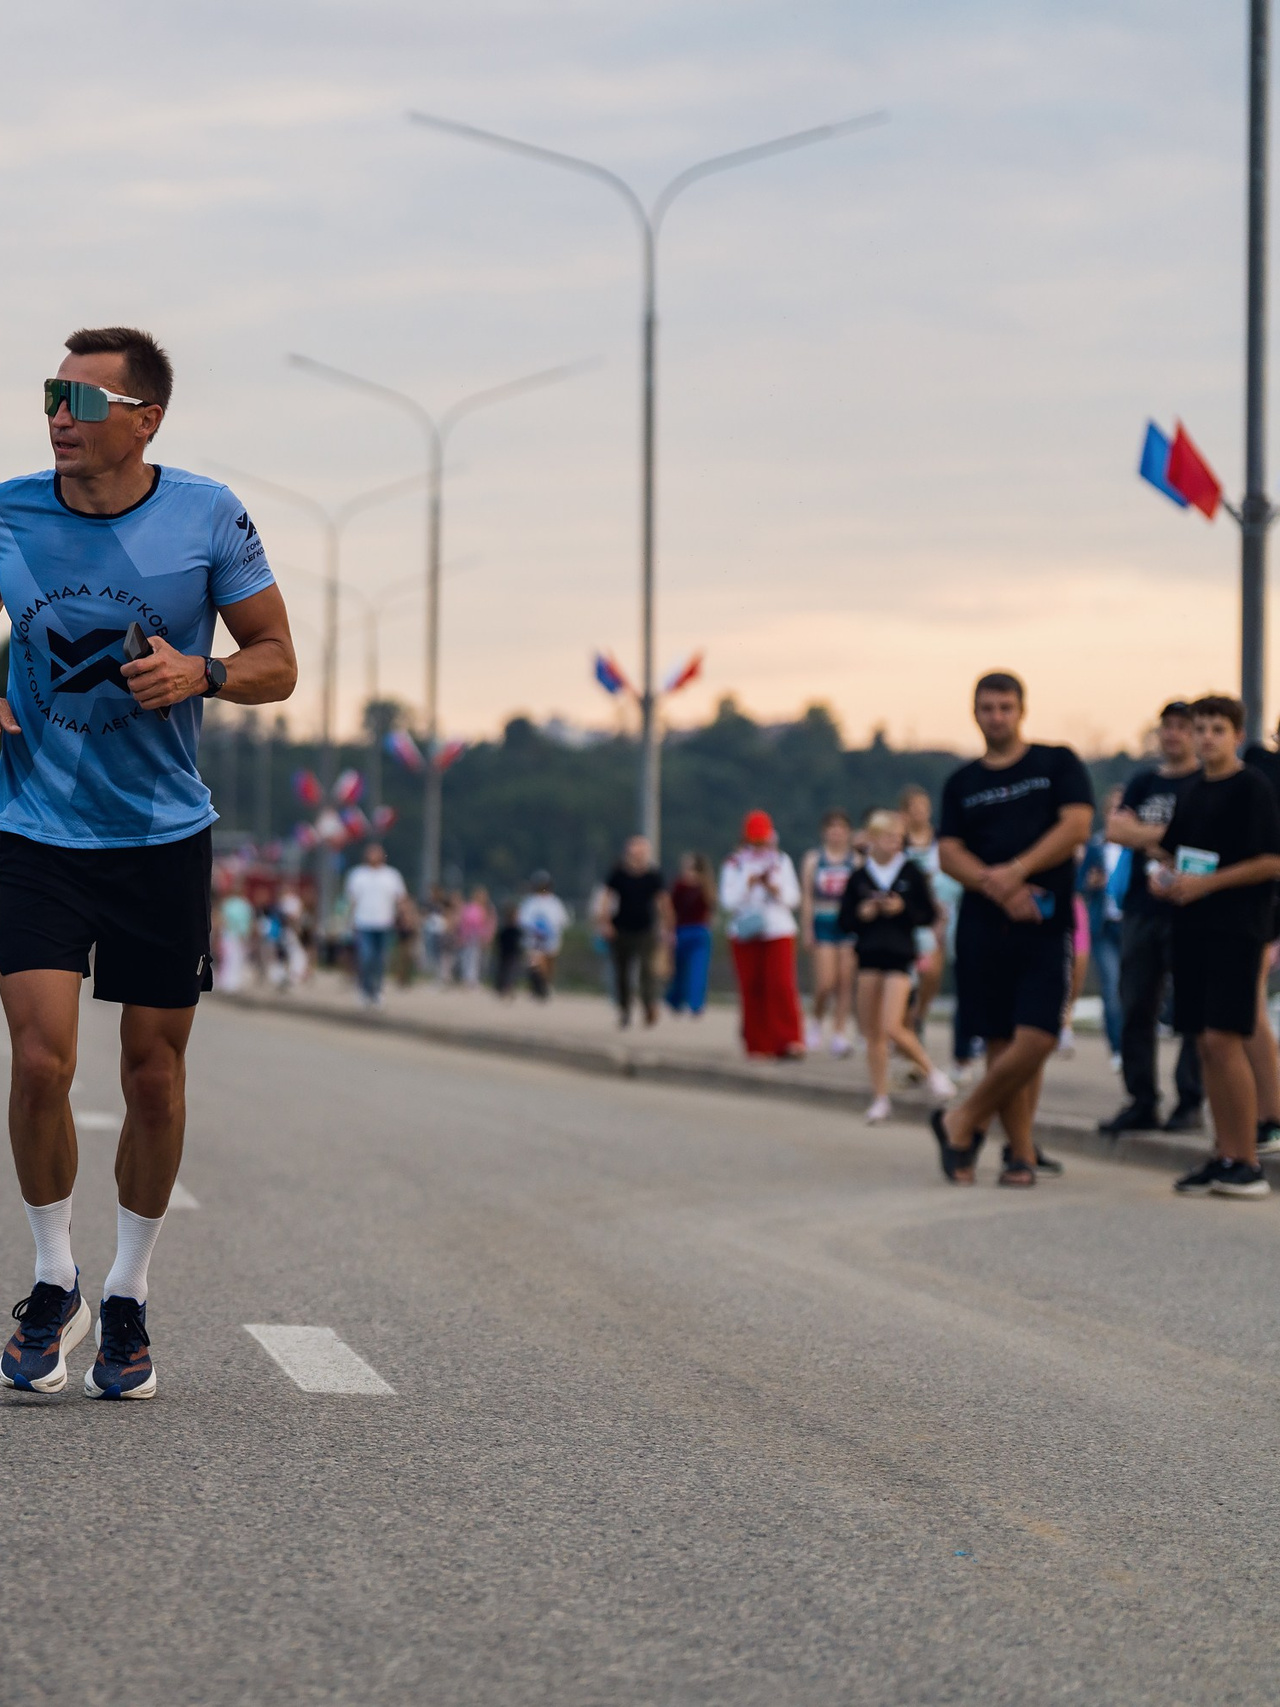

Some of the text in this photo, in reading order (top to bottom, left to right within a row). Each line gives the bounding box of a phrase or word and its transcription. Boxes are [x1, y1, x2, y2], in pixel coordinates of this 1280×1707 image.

[243, 546, 265, 566] ЛЕГКО
[20, 583, 169, 645] КОМАНДА ЛЕГКОВ
[27, 667, 144, 735] КОМАНДА ЛЕГК
